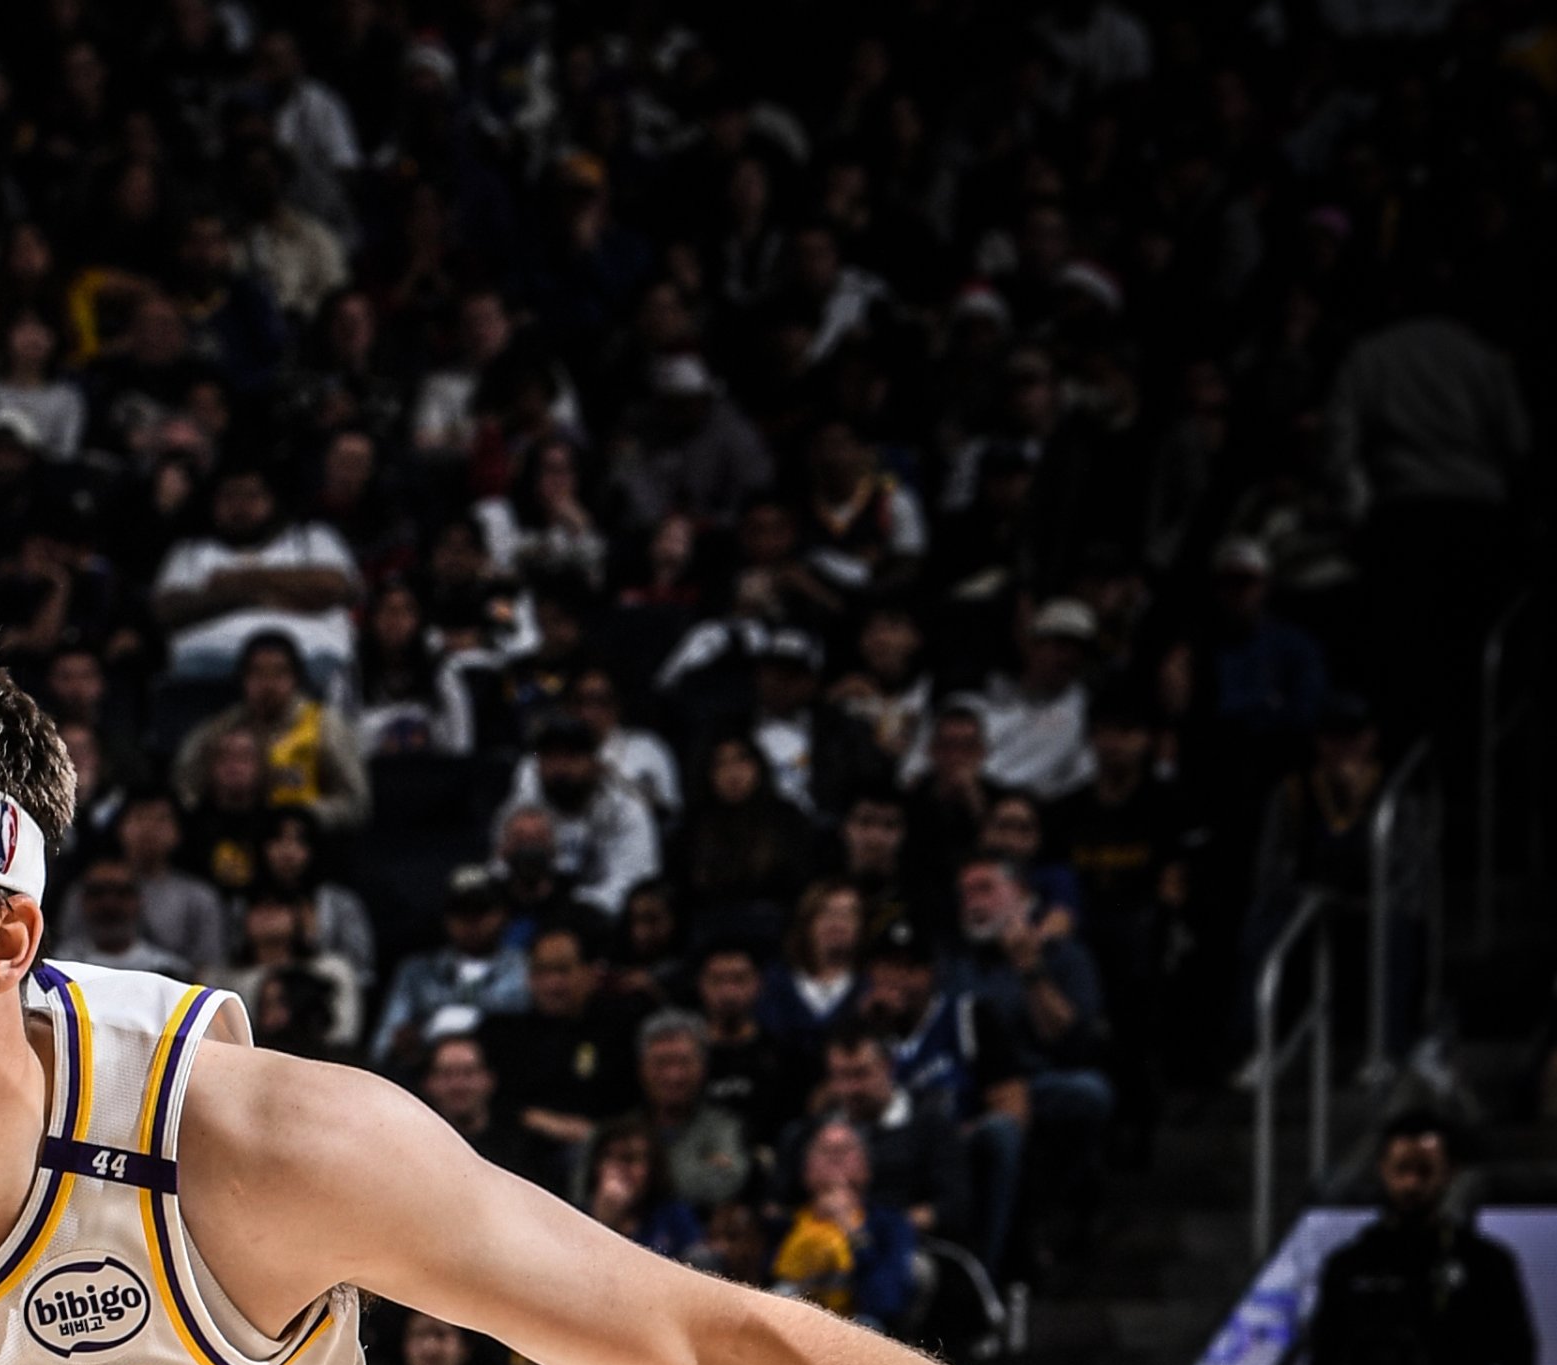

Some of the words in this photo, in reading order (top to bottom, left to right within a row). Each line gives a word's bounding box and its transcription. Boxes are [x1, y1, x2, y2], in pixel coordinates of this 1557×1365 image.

[92, 1150, 128, 1179] 44
[34, 1285, 142, 1326] bibigo
[59, 1316, 105, 1337] 비비고
